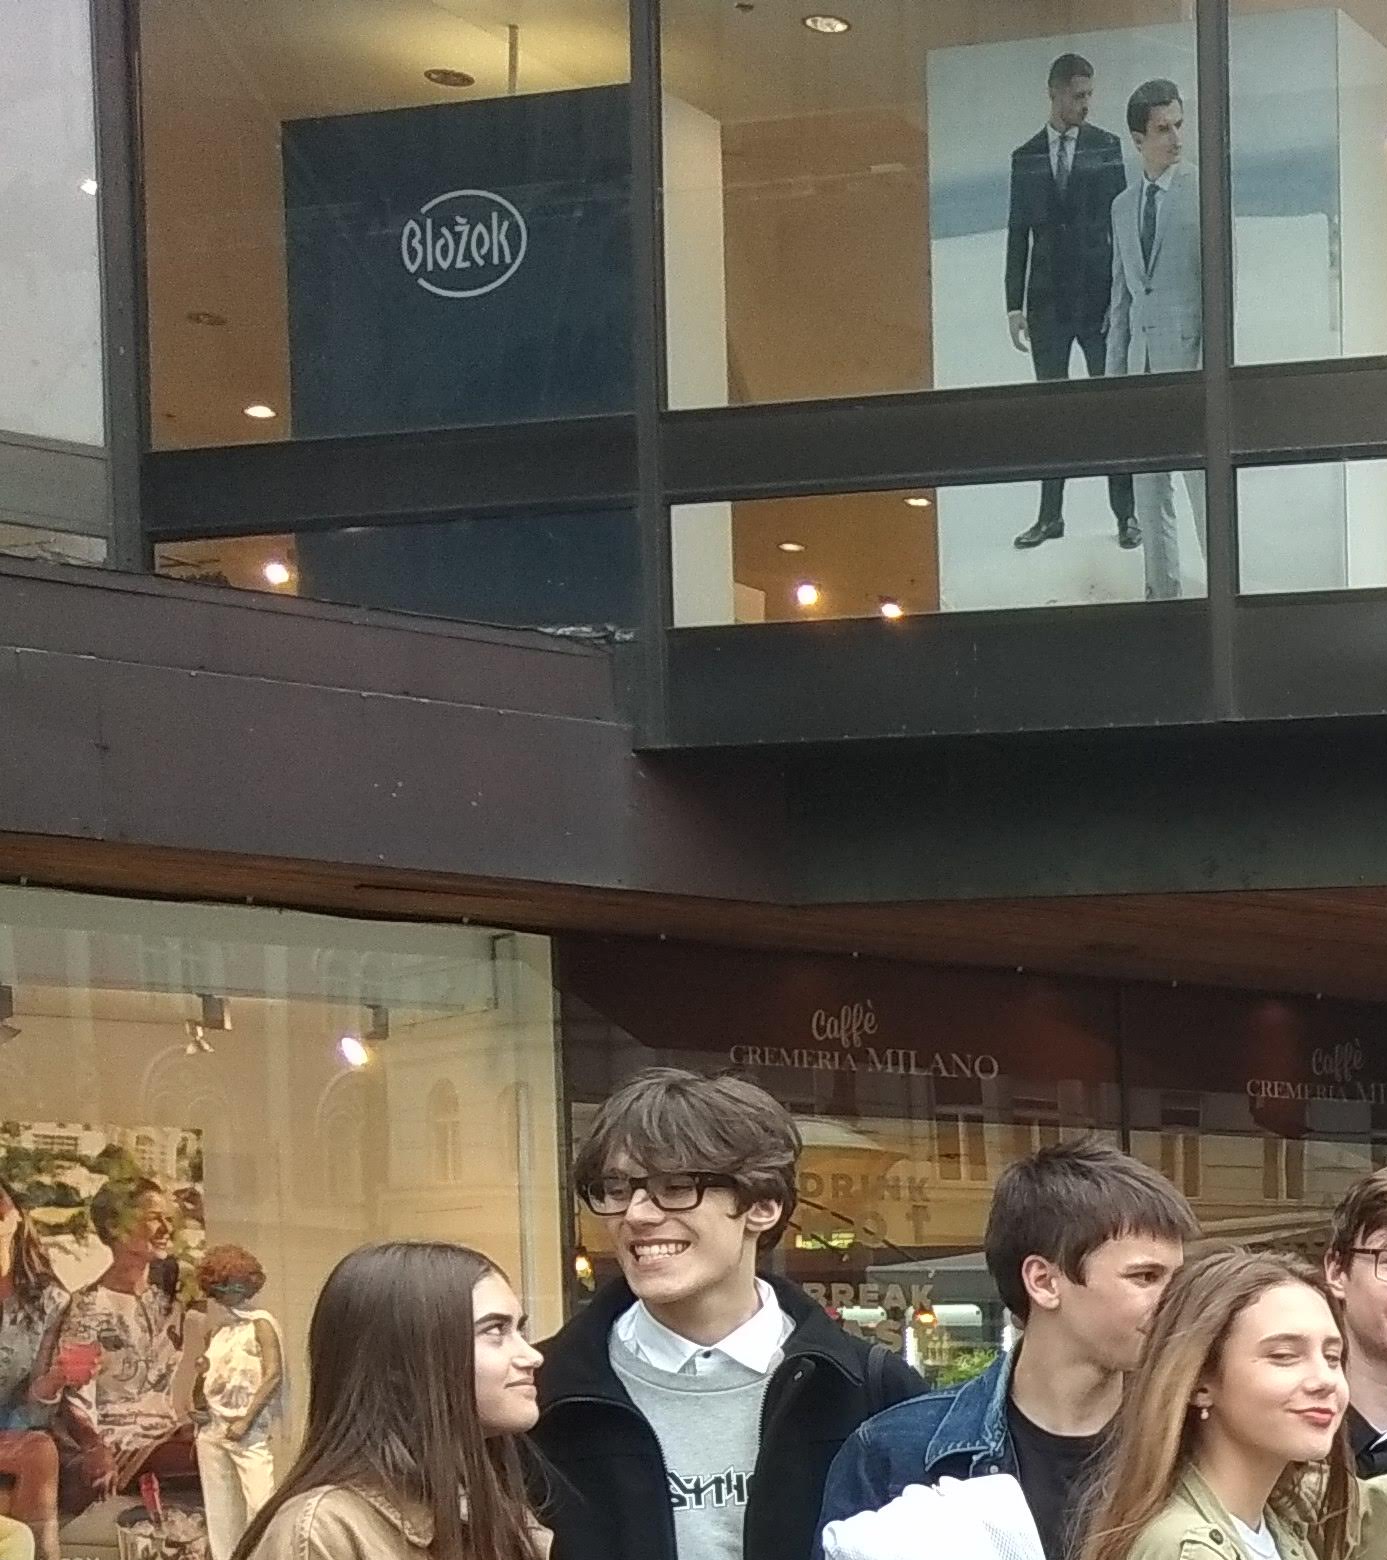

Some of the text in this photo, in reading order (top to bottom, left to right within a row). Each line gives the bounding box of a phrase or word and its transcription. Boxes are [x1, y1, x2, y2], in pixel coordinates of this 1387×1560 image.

[811, 1000, 879, 1048] Caffè
[729, 1044, 999, 1081] CREMERIA MILANO
[1311, 1038, 1365, 1082] Caffè
[1246, 1078, 1348, 1103] CREMERIA
